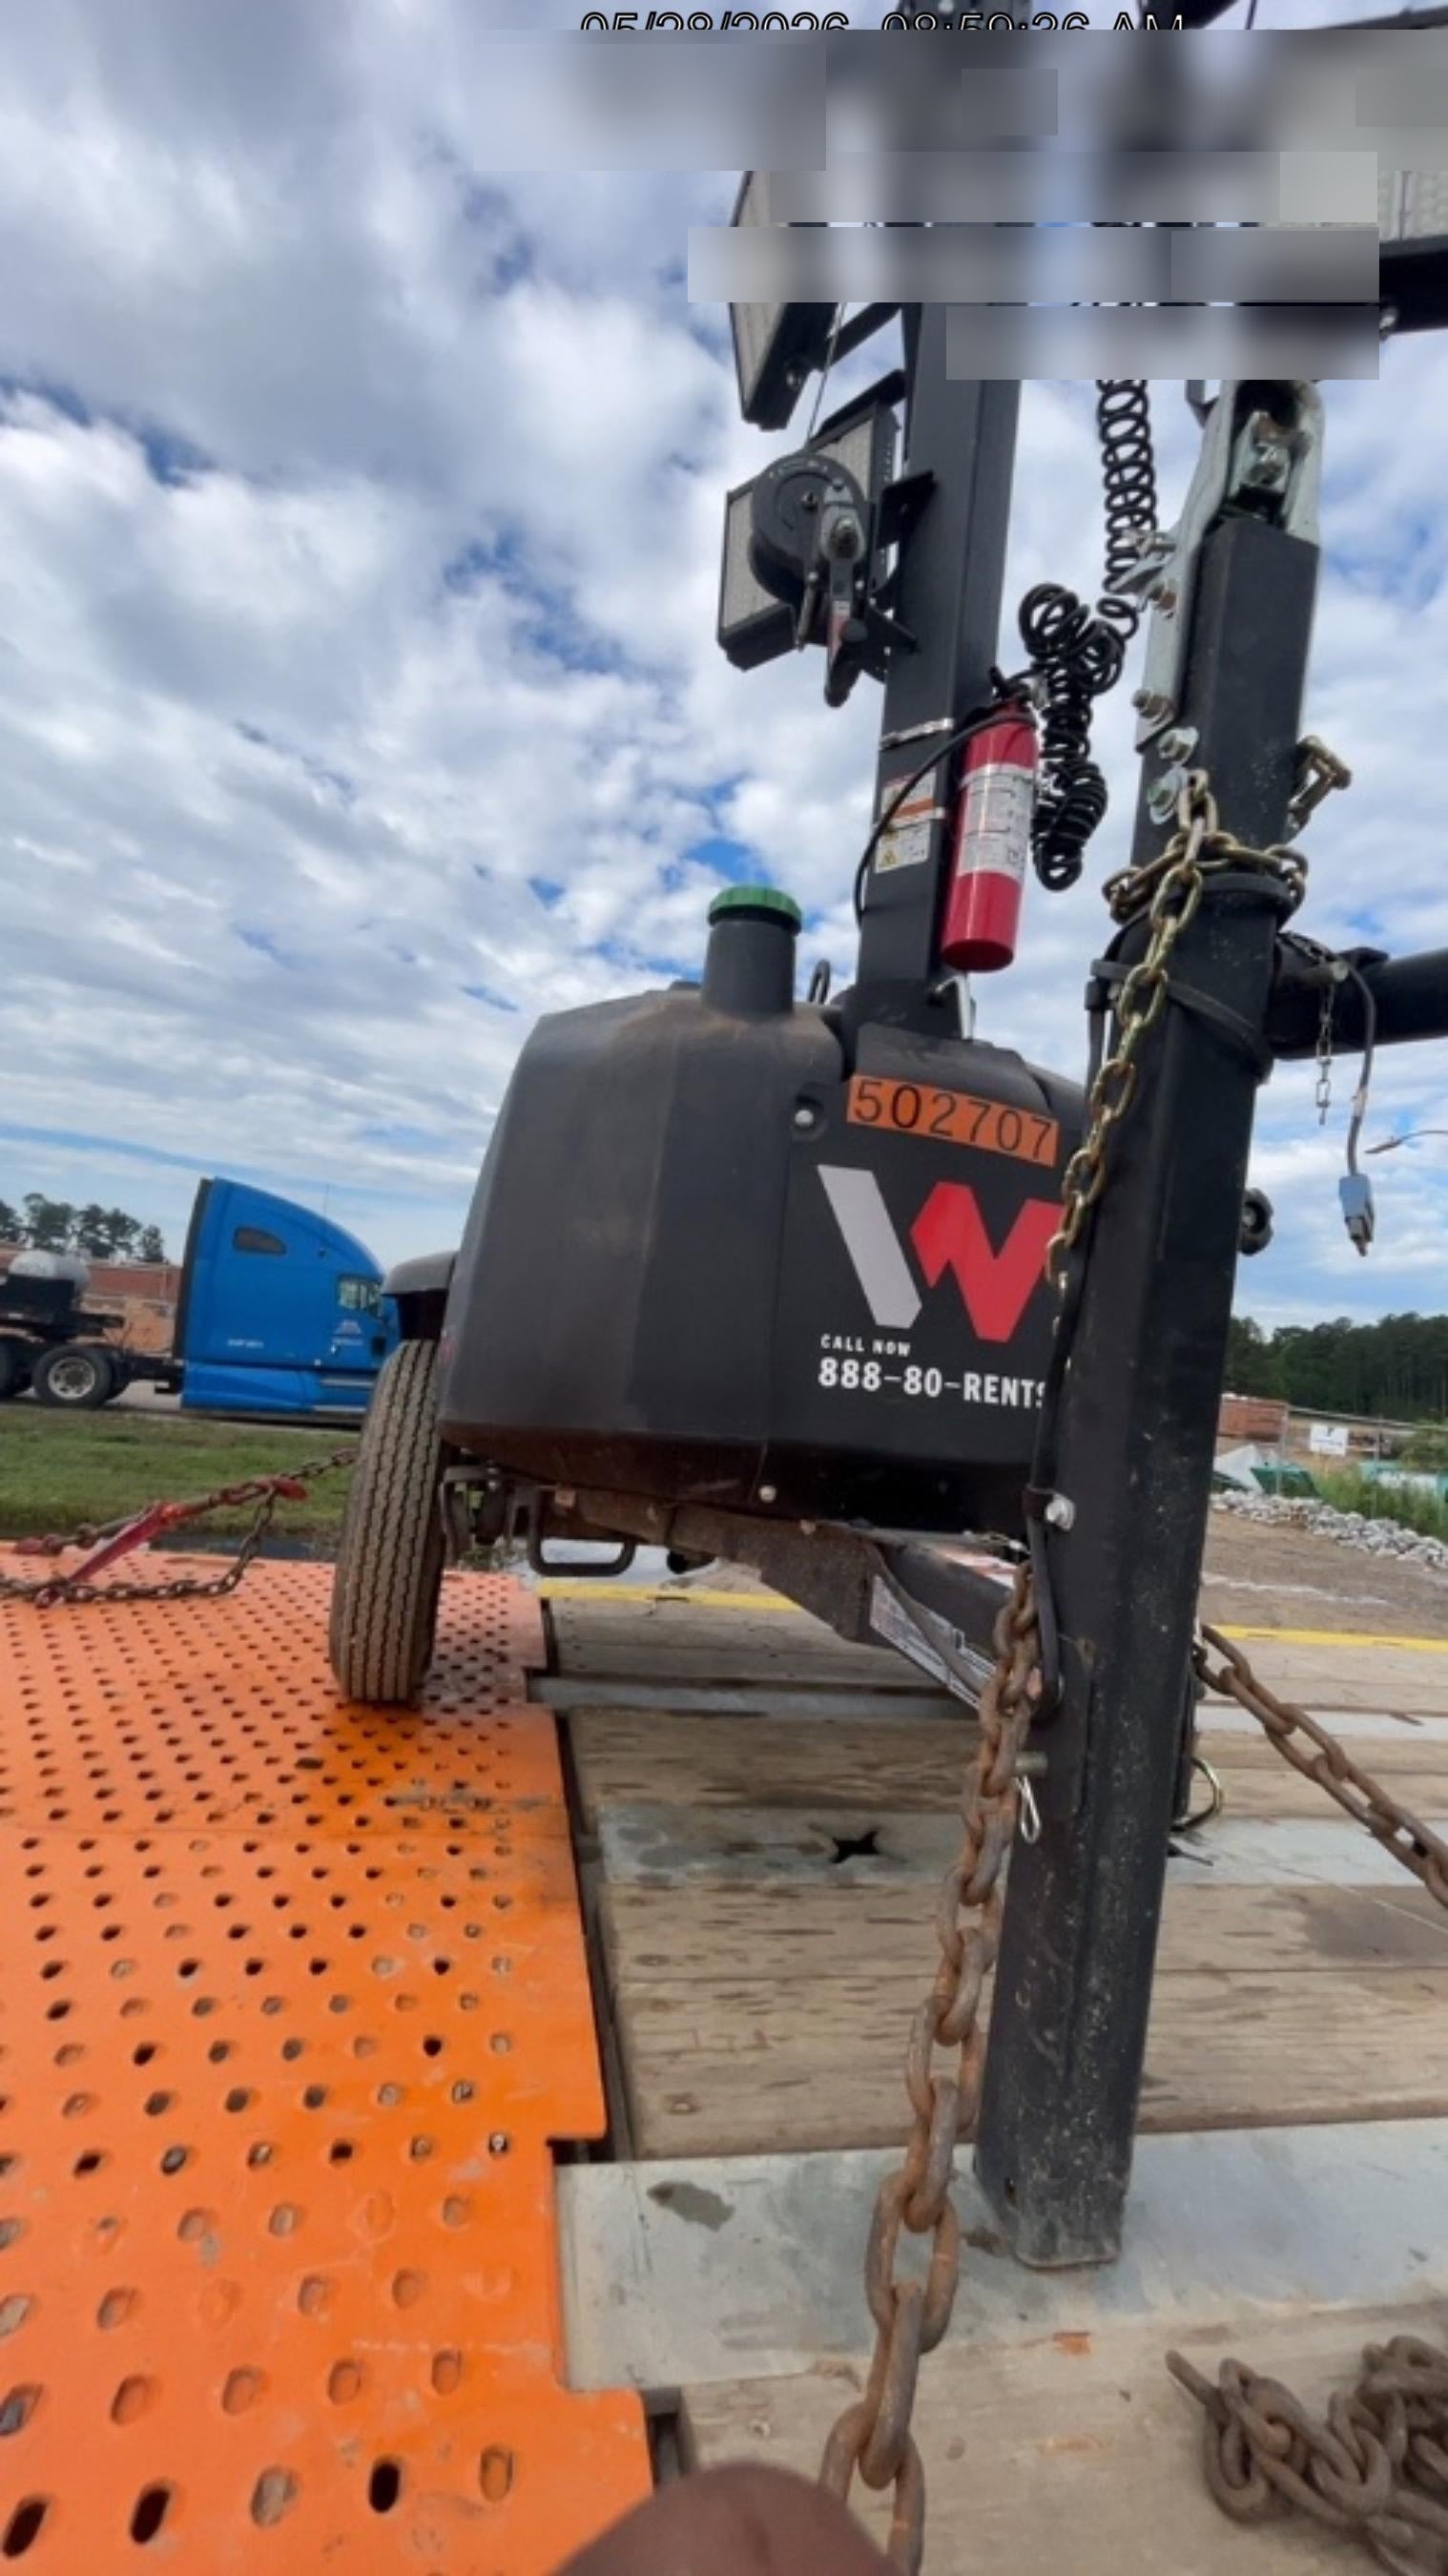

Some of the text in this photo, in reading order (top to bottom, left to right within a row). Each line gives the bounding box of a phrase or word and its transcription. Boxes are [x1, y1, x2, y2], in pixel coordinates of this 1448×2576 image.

[855, 1079, 1052, 1158] 502707
[820, 1334, 911, 1357] CALL NOW
